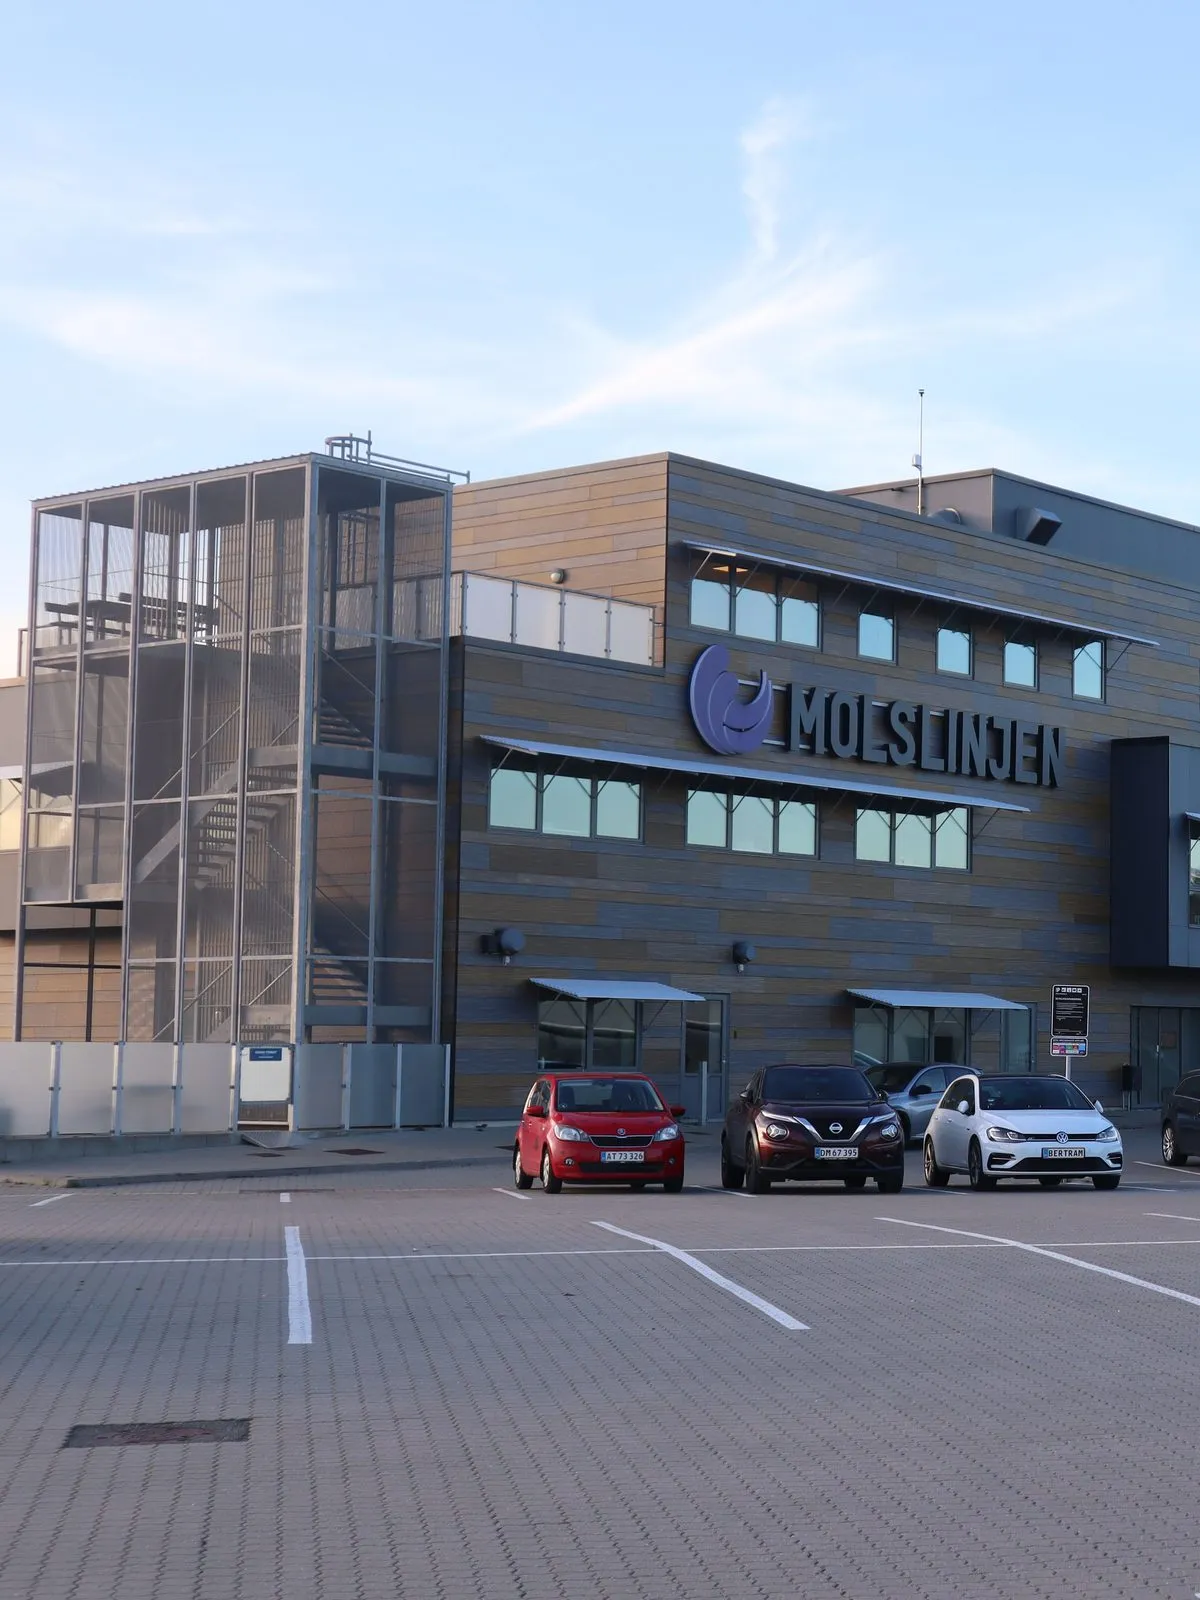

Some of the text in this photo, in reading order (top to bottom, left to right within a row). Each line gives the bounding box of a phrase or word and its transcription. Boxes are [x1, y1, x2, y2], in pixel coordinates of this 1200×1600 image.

[785, 683, 1068, 788] MOLSLINJEN
[606, 1152, 643, 1160] AT 73 326
[820, 1149, 857, 1157] DM 67 395
[1048, 1149, 1084, 1157] BERTRAM
